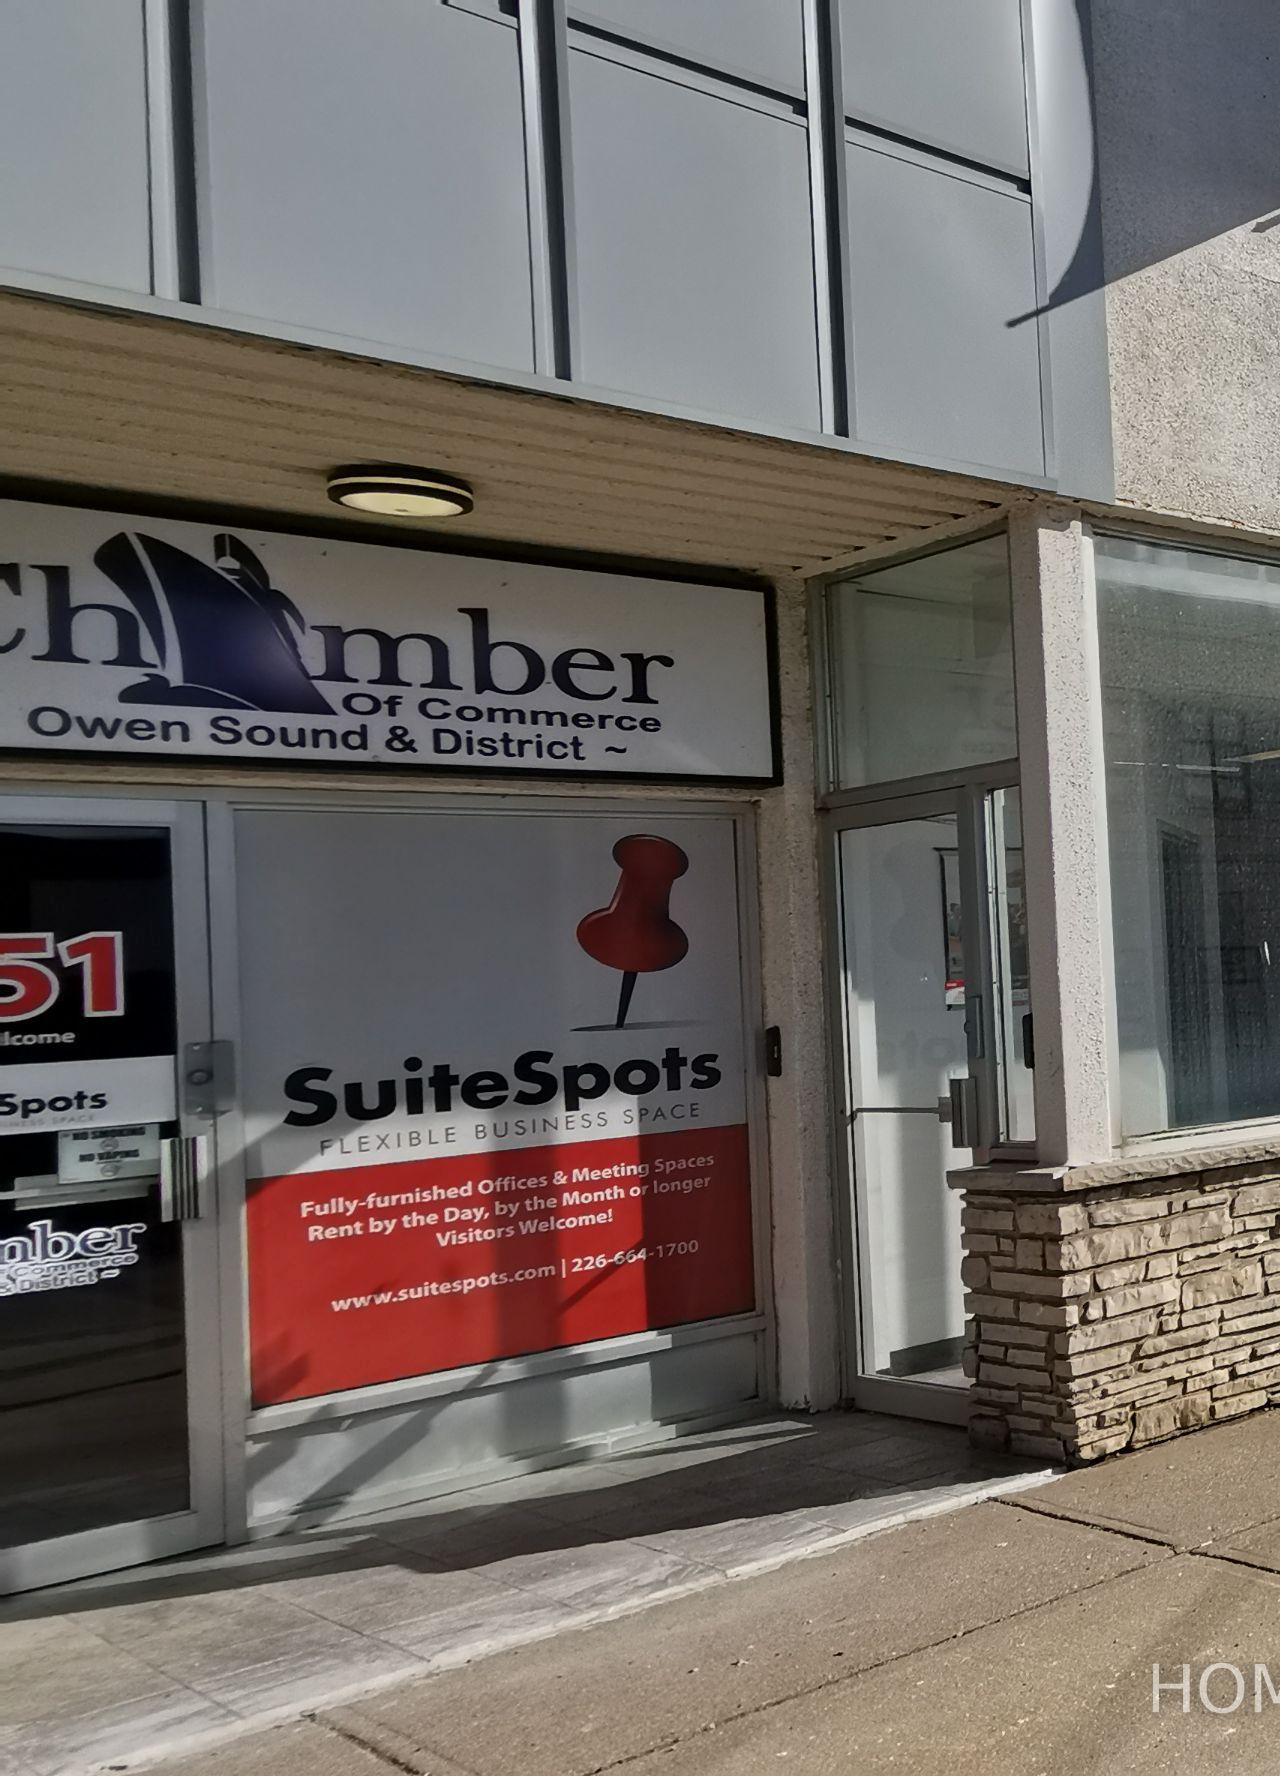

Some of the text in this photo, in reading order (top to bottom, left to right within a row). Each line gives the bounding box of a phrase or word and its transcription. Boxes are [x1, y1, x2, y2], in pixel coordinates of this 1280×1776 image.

[28, 707, 191, 743] Owen
[210, 715, 369, 754] Sound
[385, 725, 419, 755] &
[432, 727, 587, 762] District
[340, 693, 663, 735] Of Commerce
[283, 1046, 722, 1128] SuiteSpots
[319, 1102, 701, 1157] FLEXIBLE BUSINESS SPACE
[300, 1153, 716, 1220] Fully-furnished Offices & Meeting Spaces
[307, 1174, 712, 1243] Rent by the Day, by the Month or longer
[435, 1209, 614, 1248] Visitors Welcome!
[13, 1253, 138, 1277] Commerce
[19, 1270, 98, 1292] District
[331, 1261, 557, 1313] www.suitespots.com
[570, 1239, 700, 1273] 226-664-1700
